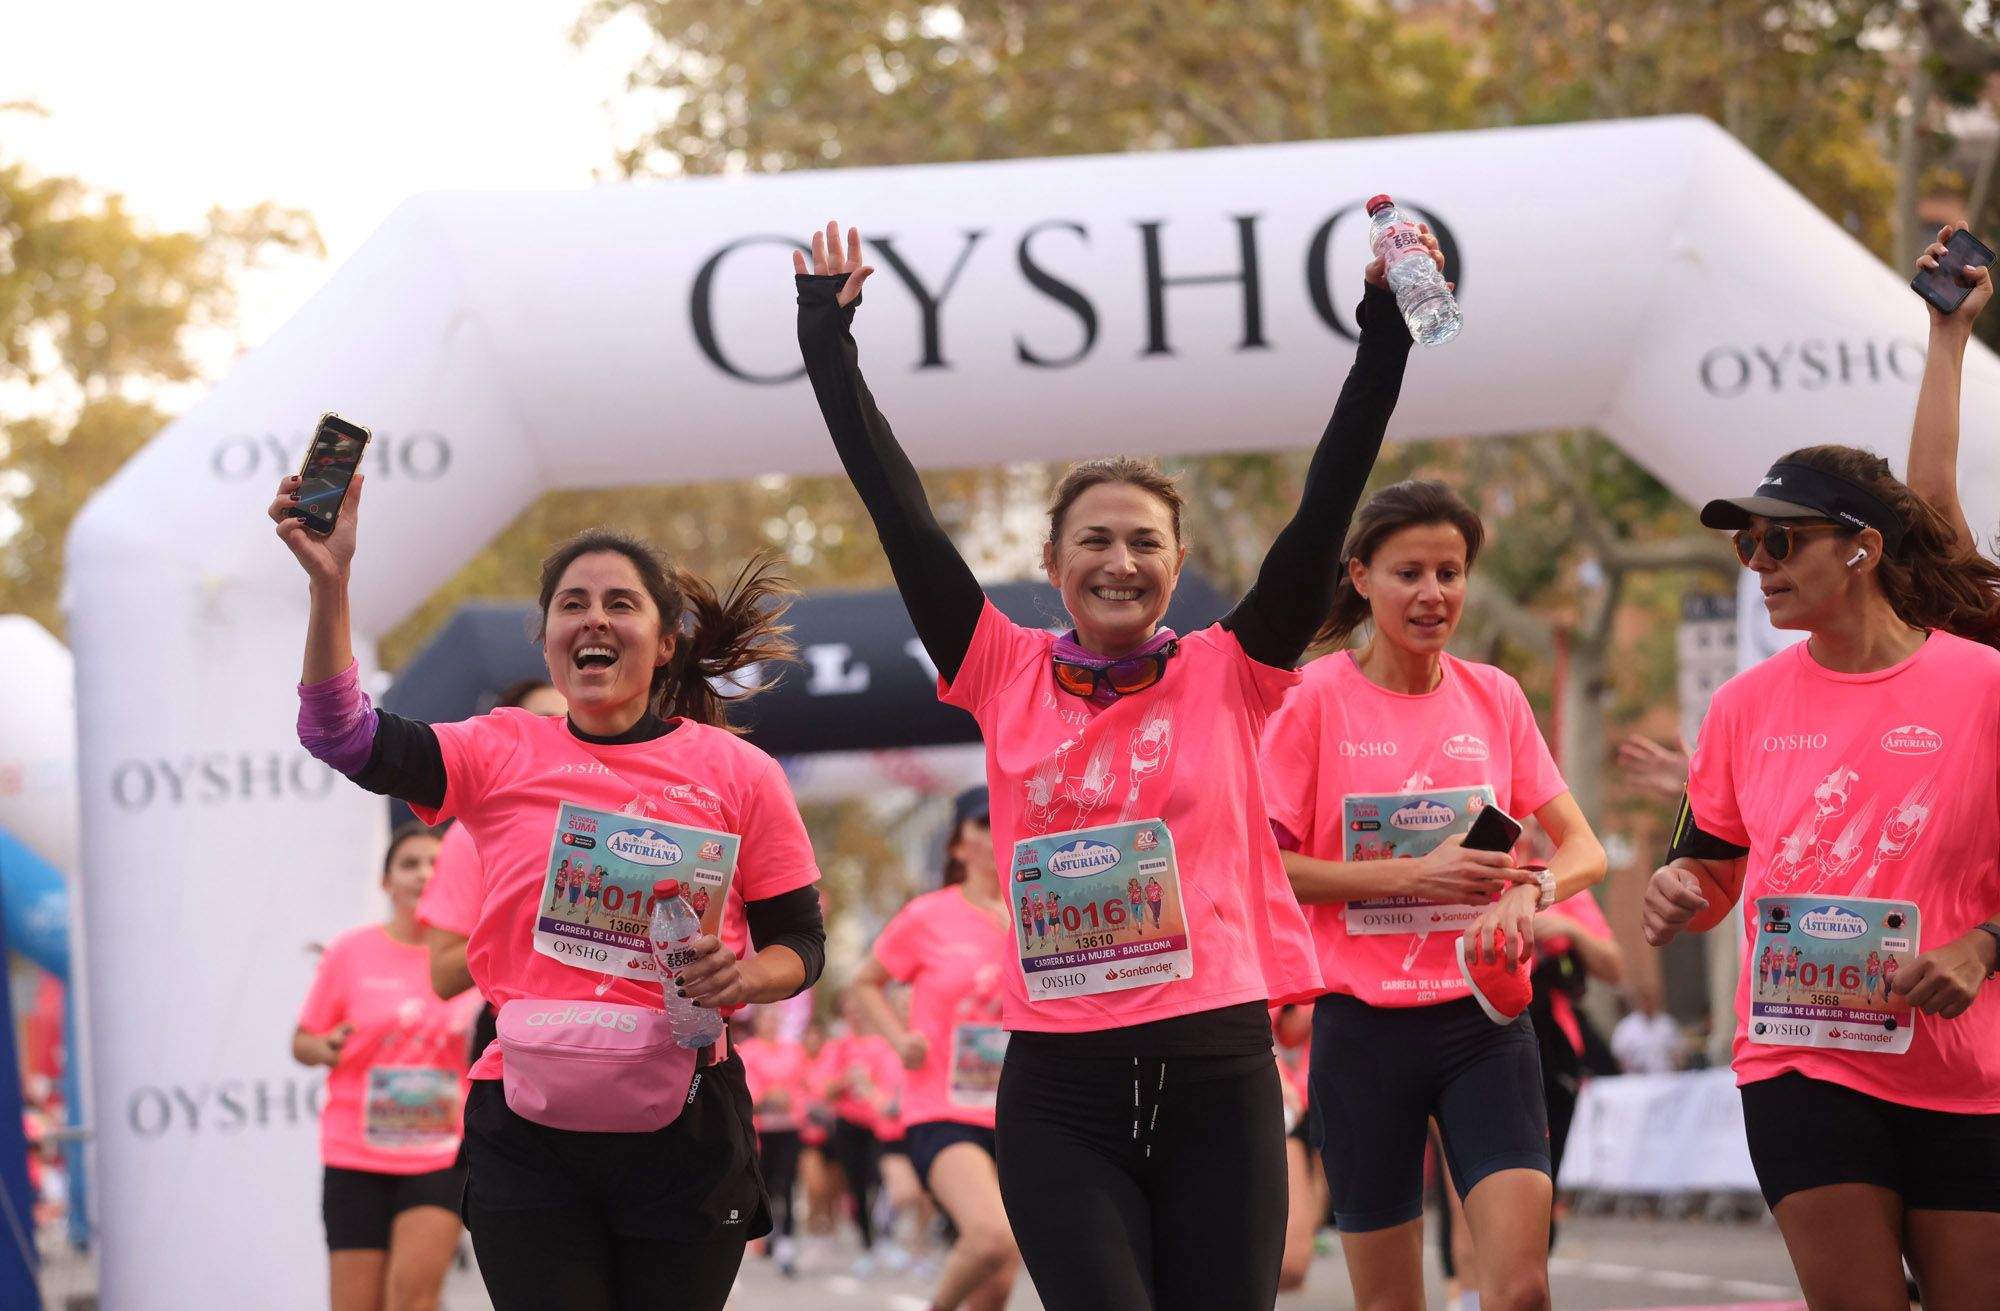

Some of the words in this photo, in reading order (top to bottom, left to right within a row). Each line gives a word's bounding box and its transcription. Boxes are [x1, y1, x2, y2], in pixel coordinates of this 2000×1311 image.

[688, 198, 1465, 386] OYSHO
[1699, 337, 1927, 400] OYSHO
[1340, 740, 1397, 758] OYSHO
[1764, 733, 1827, 752] OYSHO
[1885, 737, 1937, 749] ASTURIANA
[111, 749, 335, 814] OYSHO
[568, 820, 597, 834] SUMA
[1394, 813, 1451, 826] ASTURIANA
[1137, 831, 1154, 845] 20
[610, 836, 676, 862] ASTURIANA
[703, 841, 720, 855] 20
[1052, 853, 1117, 873] ASTURIANA
[1062, 898, 1127, 932] 016
[1363, 913, 1413, 926] OYSHO
[609, 918, 648, 936] 13607
[1803, 917, 1863, 934] ASTURIANA
[554, 923, 591, 937] CARRERA
[593, 930, 604, 940] DE
[605, 932, 616, 942] LA
[618, 935, 646, 949] MUJER
[1075, 933, 1114, 949] 13610
[553, 940, 608, 962] OYSHO
[1034, 955, 1065, 968] CARRERA
[1066, 954, 1076, 964] DE
[1077, 953, 1087, 962] LA
[1088, 949, 1116, 961] MUJER
[1123, 940, 1172, 956] BARCELONA
[1119, 961, 1173, 979] Santander
[1799, 962, 1861, 990] 016
[1042, 972, 1086, 989] OYSHO
[1381, 980, 1417, 990] CARRERA
[1419, 980, 1428, 990] DE
[1430, 980, 1440, 989] LA
[1810, 994, 1839, 1006] 3568
[526, 1006, 638, 1033] adidas
[1764, 1005, 1793, 1015] CARRERA
[1795, 1006, 1804, 1015] DE
[1805, 1007, 1815, 1016] LA
[1816, 1009, 1843, 1018] MUJER
[1764, 1022, 1811, 1037] OYSHO
[1842, 1030, 1894, 1043] Santander
[687, 1073, 702, 1104] adidas
